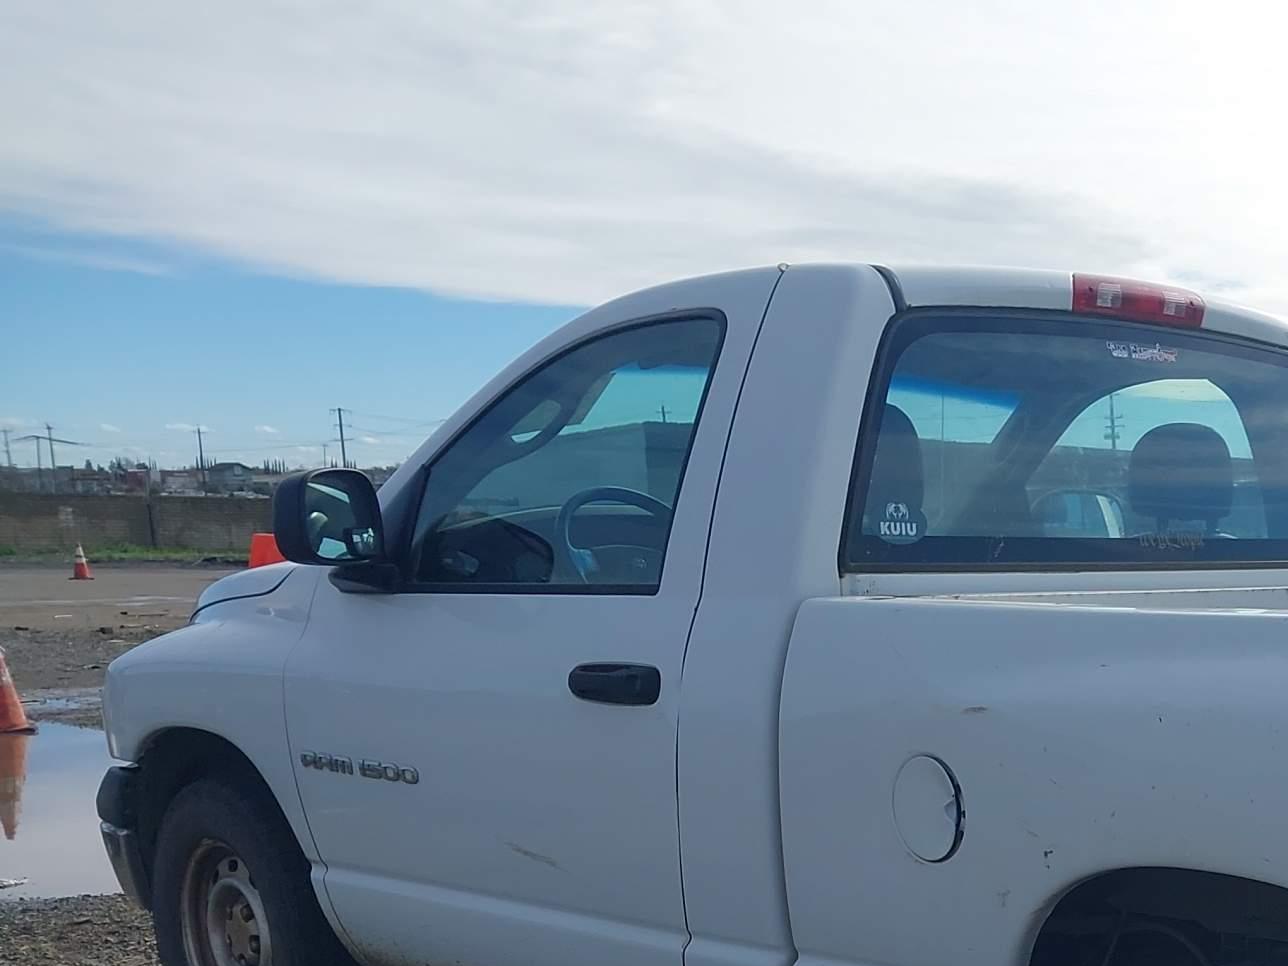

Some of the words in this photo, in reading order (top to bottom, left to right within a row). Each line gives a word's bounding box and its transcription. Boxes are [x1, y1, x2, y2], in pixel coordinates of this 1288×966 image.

[879, 521, 918, 537] KUIU
[300, 750, 354, 776] RAM
[358, 758, 420, 785] 1500
